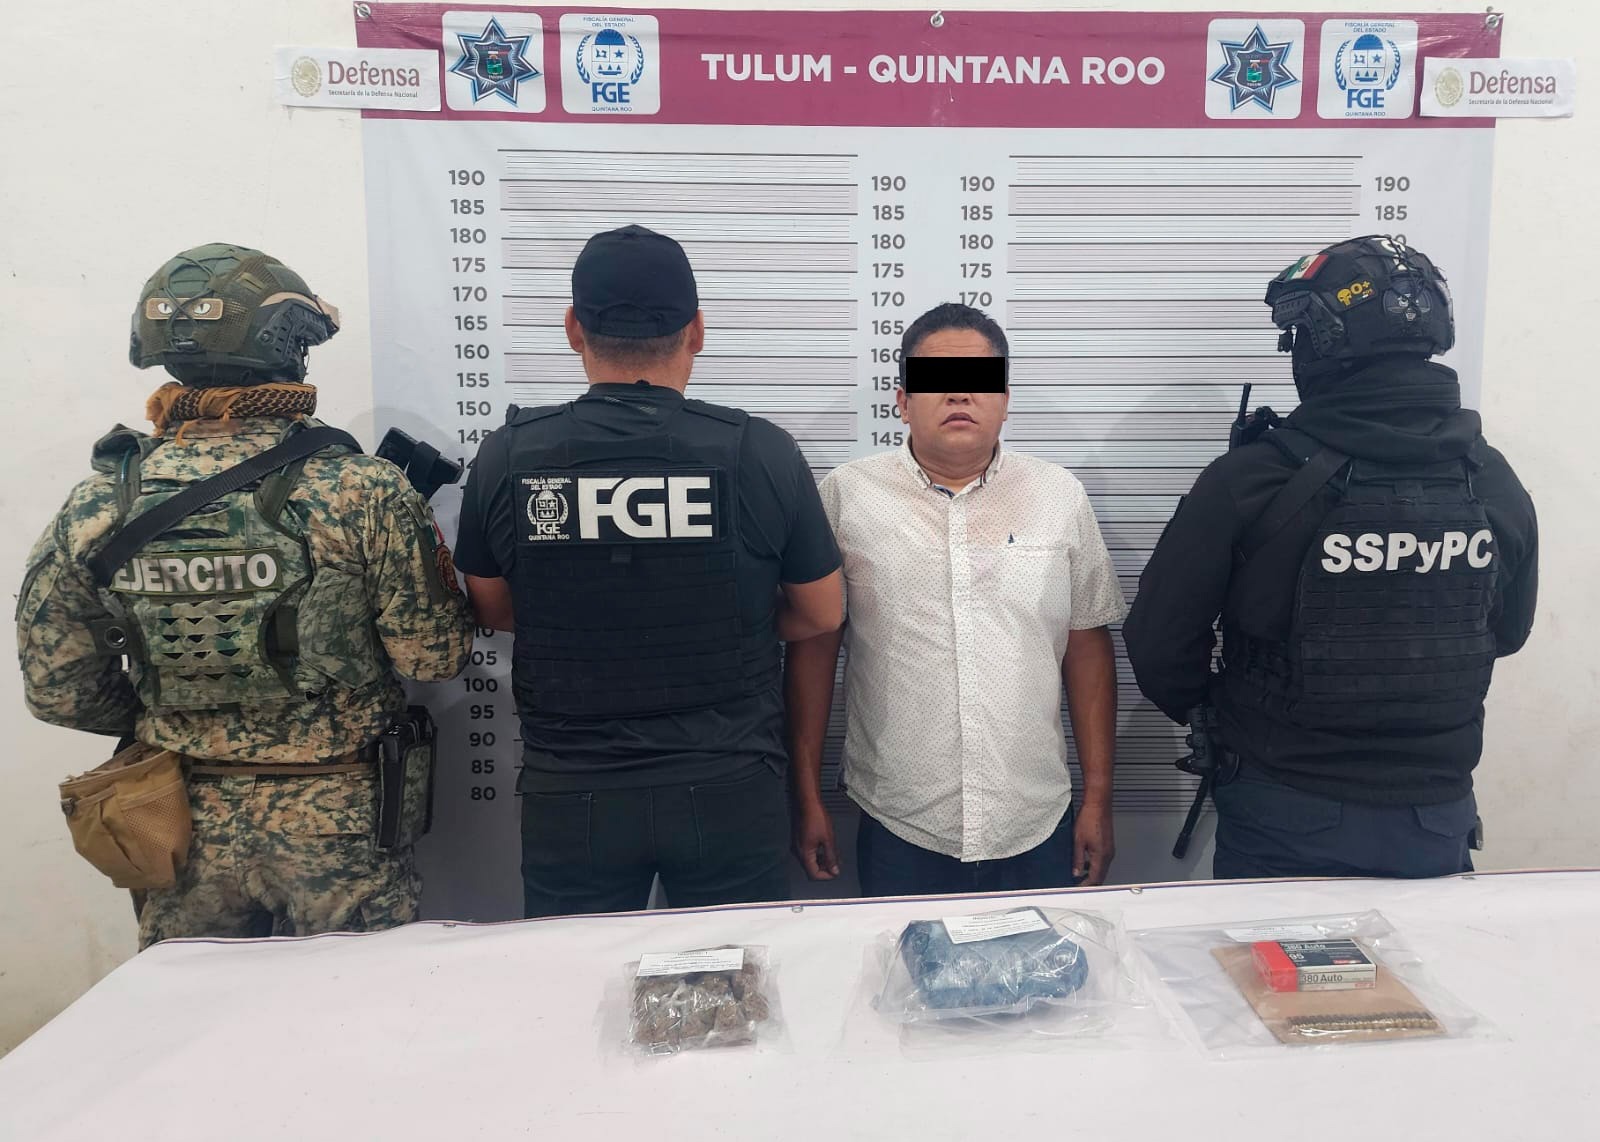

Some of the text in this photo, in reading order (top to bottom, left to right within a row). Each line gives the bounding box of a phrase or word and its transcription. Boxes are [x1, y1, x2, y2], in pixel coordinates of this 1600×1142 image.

[328, 60, 420, 87] Defensa
[701, 54, 1165, 85] TULUM - QUINTANA ROO
[1469, 69, 1556, 94] Defensa
[592, 82, 630, 103] FGE
[1347, 88, 1384, 109] FGE
[448, 170, 485, 186] 190
[872, 176, 906, 191] 190
[960, 176, 995, 191] 190
[1375, 176, 1410, 192] 190
[450, 199, 484, 215] 185
[872, 205, 905, 220] 185
[961, 205, 993, 220] 185
[1375, 205, 1407, 220] 185
[450, 228, 486, 244] 180
[872, 234, 905, 249] 180
[960, 234, 993, 249] 180
[452, 257, 486, 272] 175
[872, 263, 904, 278] 175
[960, 263, 992, 278] 175
[453, 286, 487, 302] 170
[872, 292, 905, 307] 170
[959, 292, 992, 306] 170
[454, 315, 488, 331] 165
[872, 320, 904, 335] 165
[454, 344, 489, 359] 160
[871, 348, 902, 363] 160
[457, 373, 489, 388] 155
[872, 376, 901, 391] 155
[457, 401, 491, 416] 150
[871, 432, 904, 446] 145
[578, 476, 713, 539] FGE
[537, 522, 560, 534] FGE
[1321, 529, 1493, 573] SSPyPC
[114, 553, 277, 592] EJERCITO
[464, 678, 498, 692] 100
[470, 704, 494, 720] 95
[469, 732, 496, 746] 90
[471, 760, 495, 774] 85
[471, 786, 496, 801] 80
[1321, 974, 1343, 982] Auto
